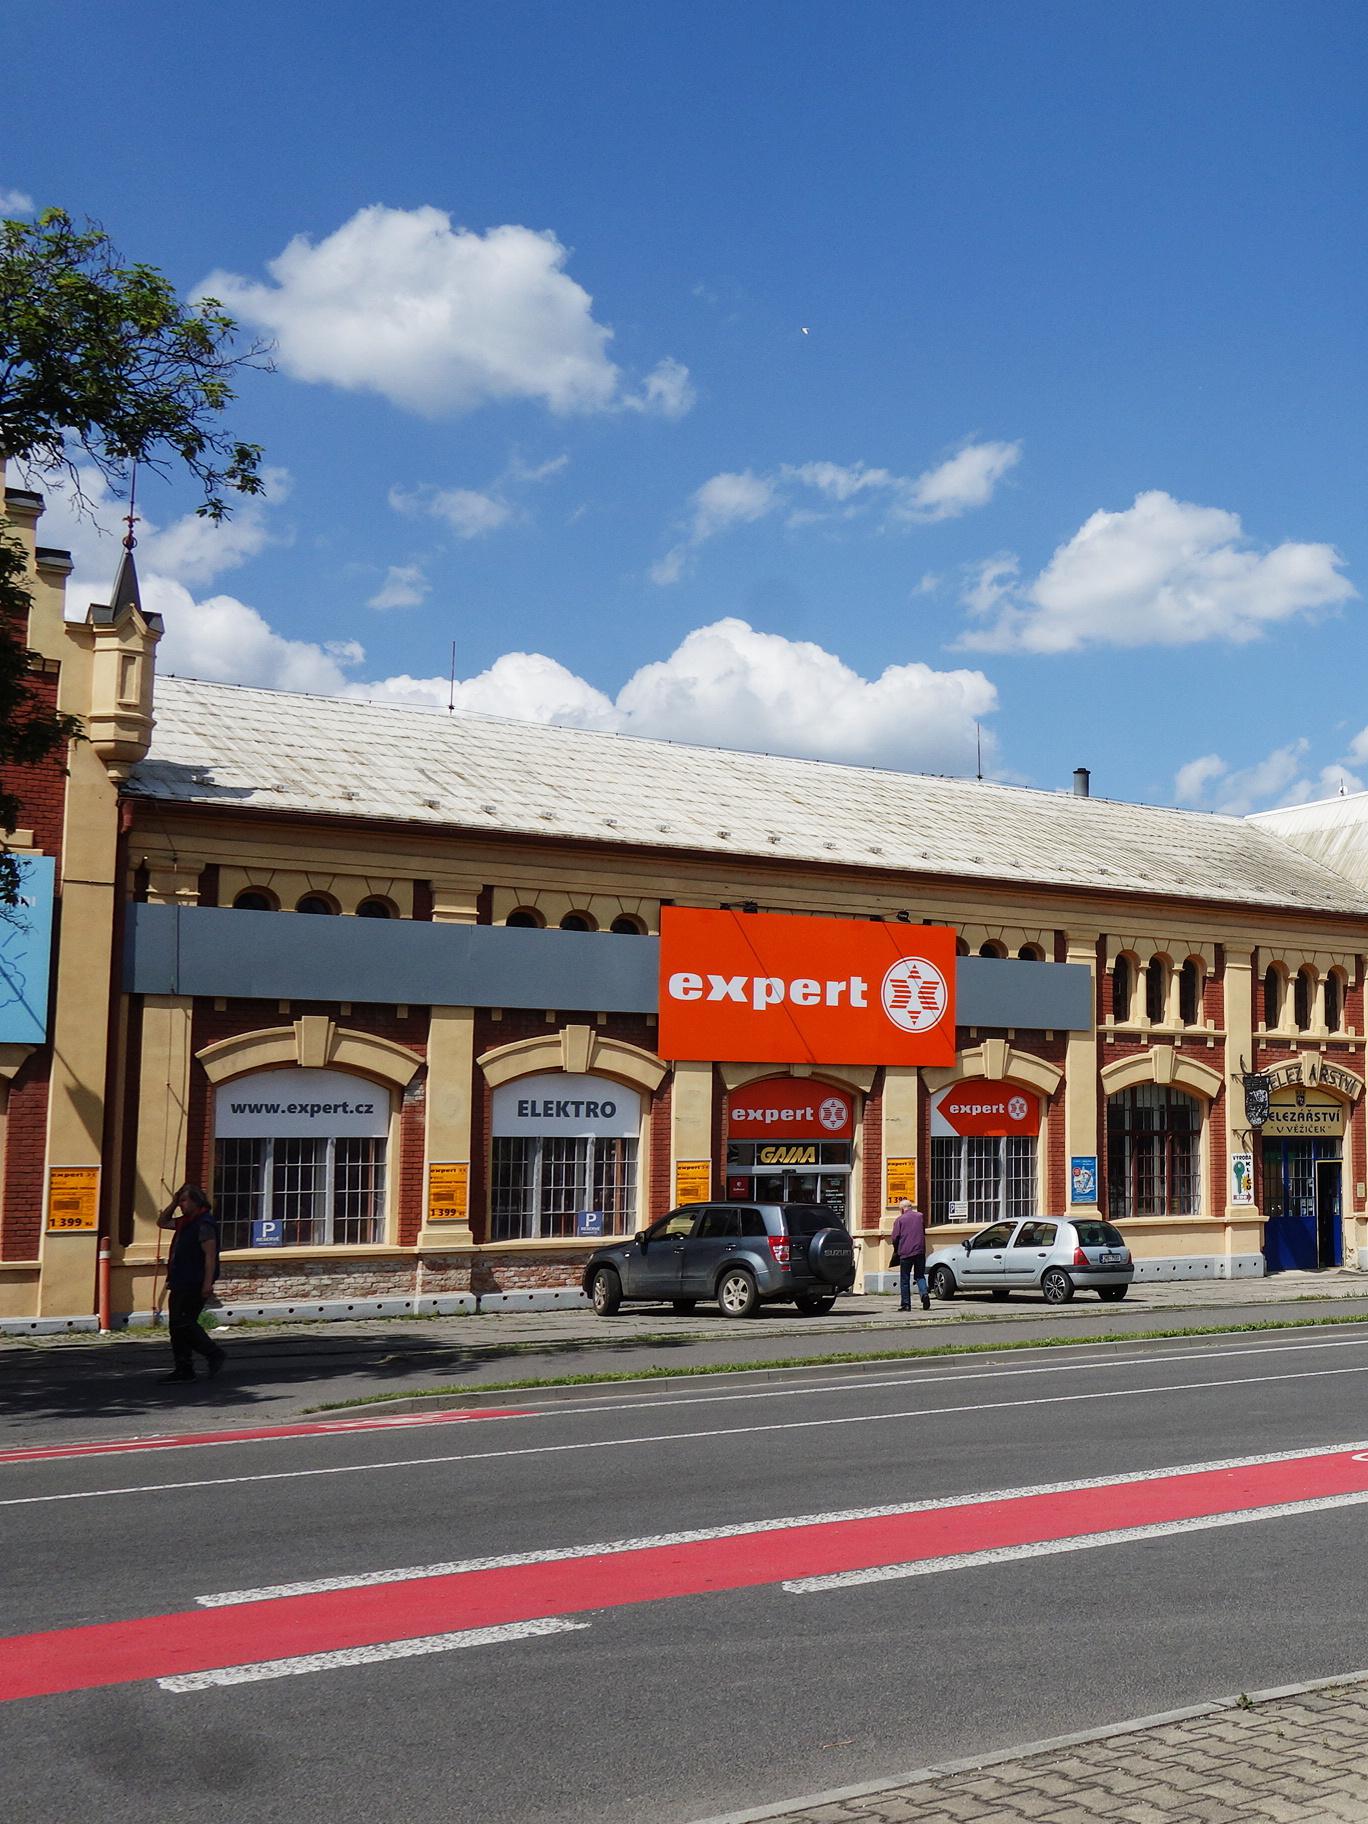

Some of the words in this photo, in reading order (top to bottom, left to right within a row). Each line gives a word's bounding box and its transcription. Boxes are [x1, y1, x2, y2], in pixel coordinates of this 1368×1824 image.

[668, 972, 868, 1011] expert
[1268, 1063, 1359, 1097] ELEZÁŘSTVÍ
[231, 1101, 374, 1118] www.expert.cz
[517, 1100, 617, 1119] ELEKTRO
[731, 1106, 814, 1124] expert
[949, 1103, 1005, 1116] expert
[1268, 1109, 1340, 1122] ELEZÁŘSTVÍ
[438, 1208, 457, 1217] 399
[585, 1213, 597, 1227] P
[50, 1218, 56, 1227] 1
[60, 1217, 82, 1227] 399
[262, 1221, 276, 1238] P
